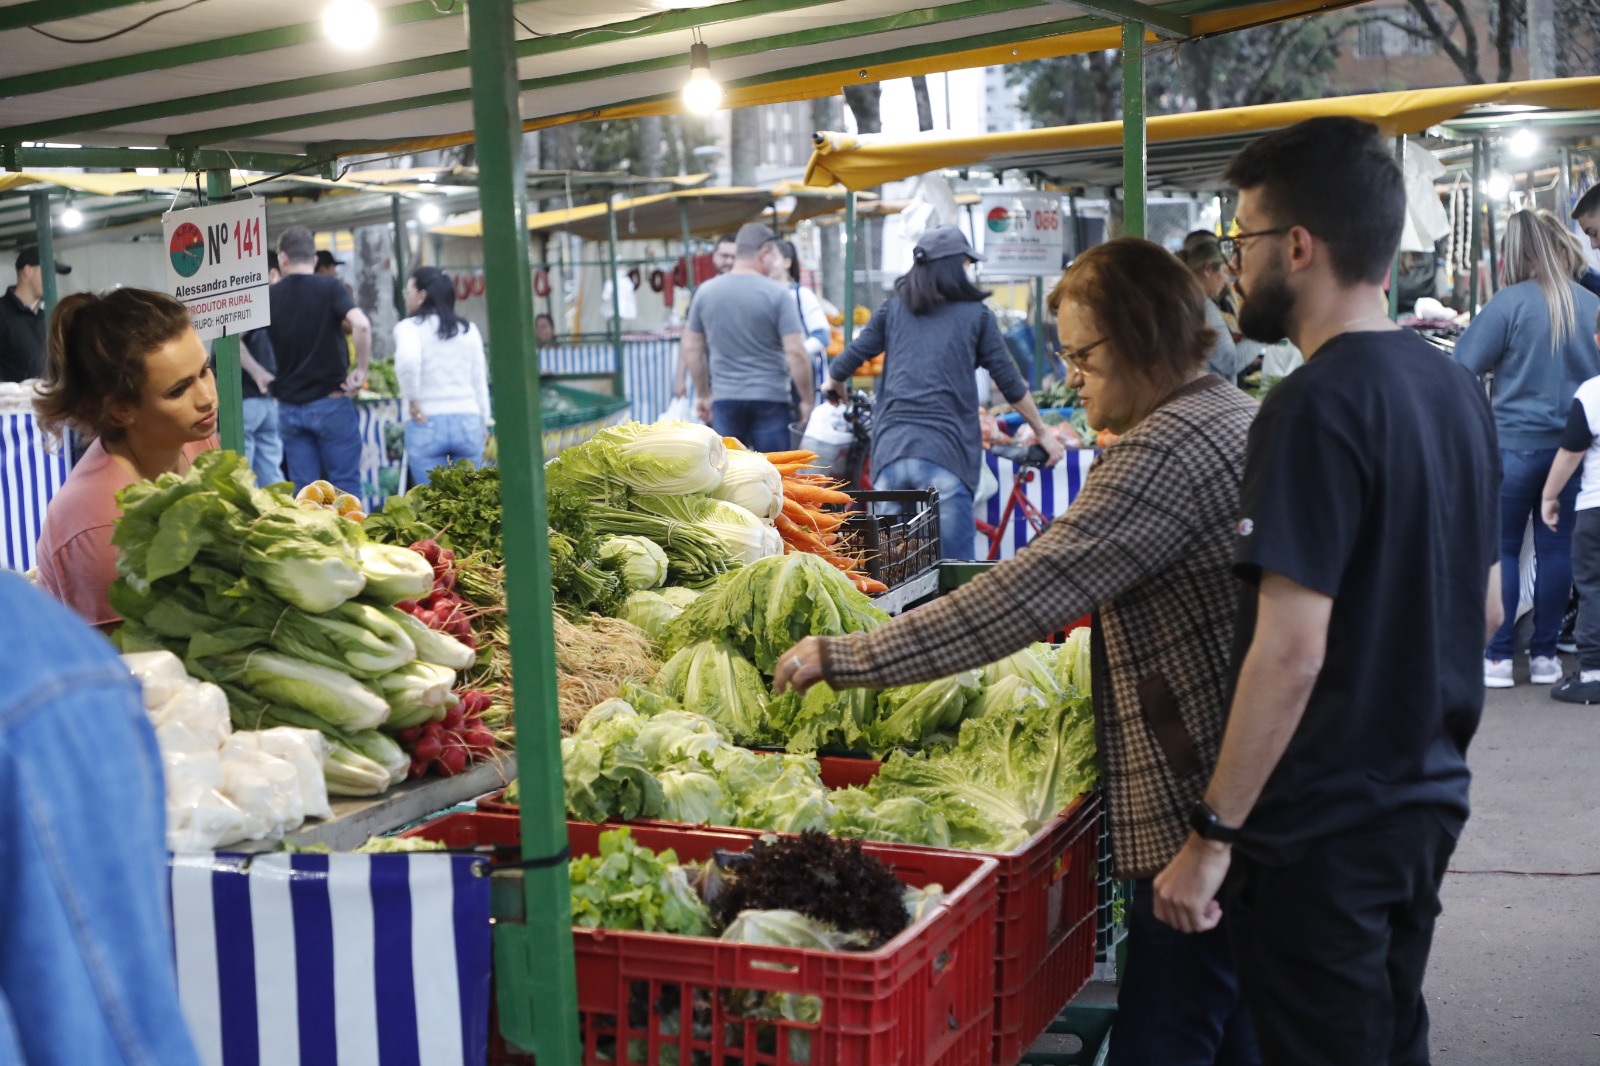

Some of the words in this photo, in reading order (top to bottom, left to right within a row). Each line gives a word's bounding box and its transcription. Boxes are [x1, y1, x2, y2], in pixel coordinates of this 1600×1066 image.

[234, 217, 260, 259] 141
[175, 279, 228, 298] Alessandra
[229, 272, 262, 287] Pereira
[228, 294, 253, 309] RURAL
[215, 309, 252, 326] HORTIFRUTI
